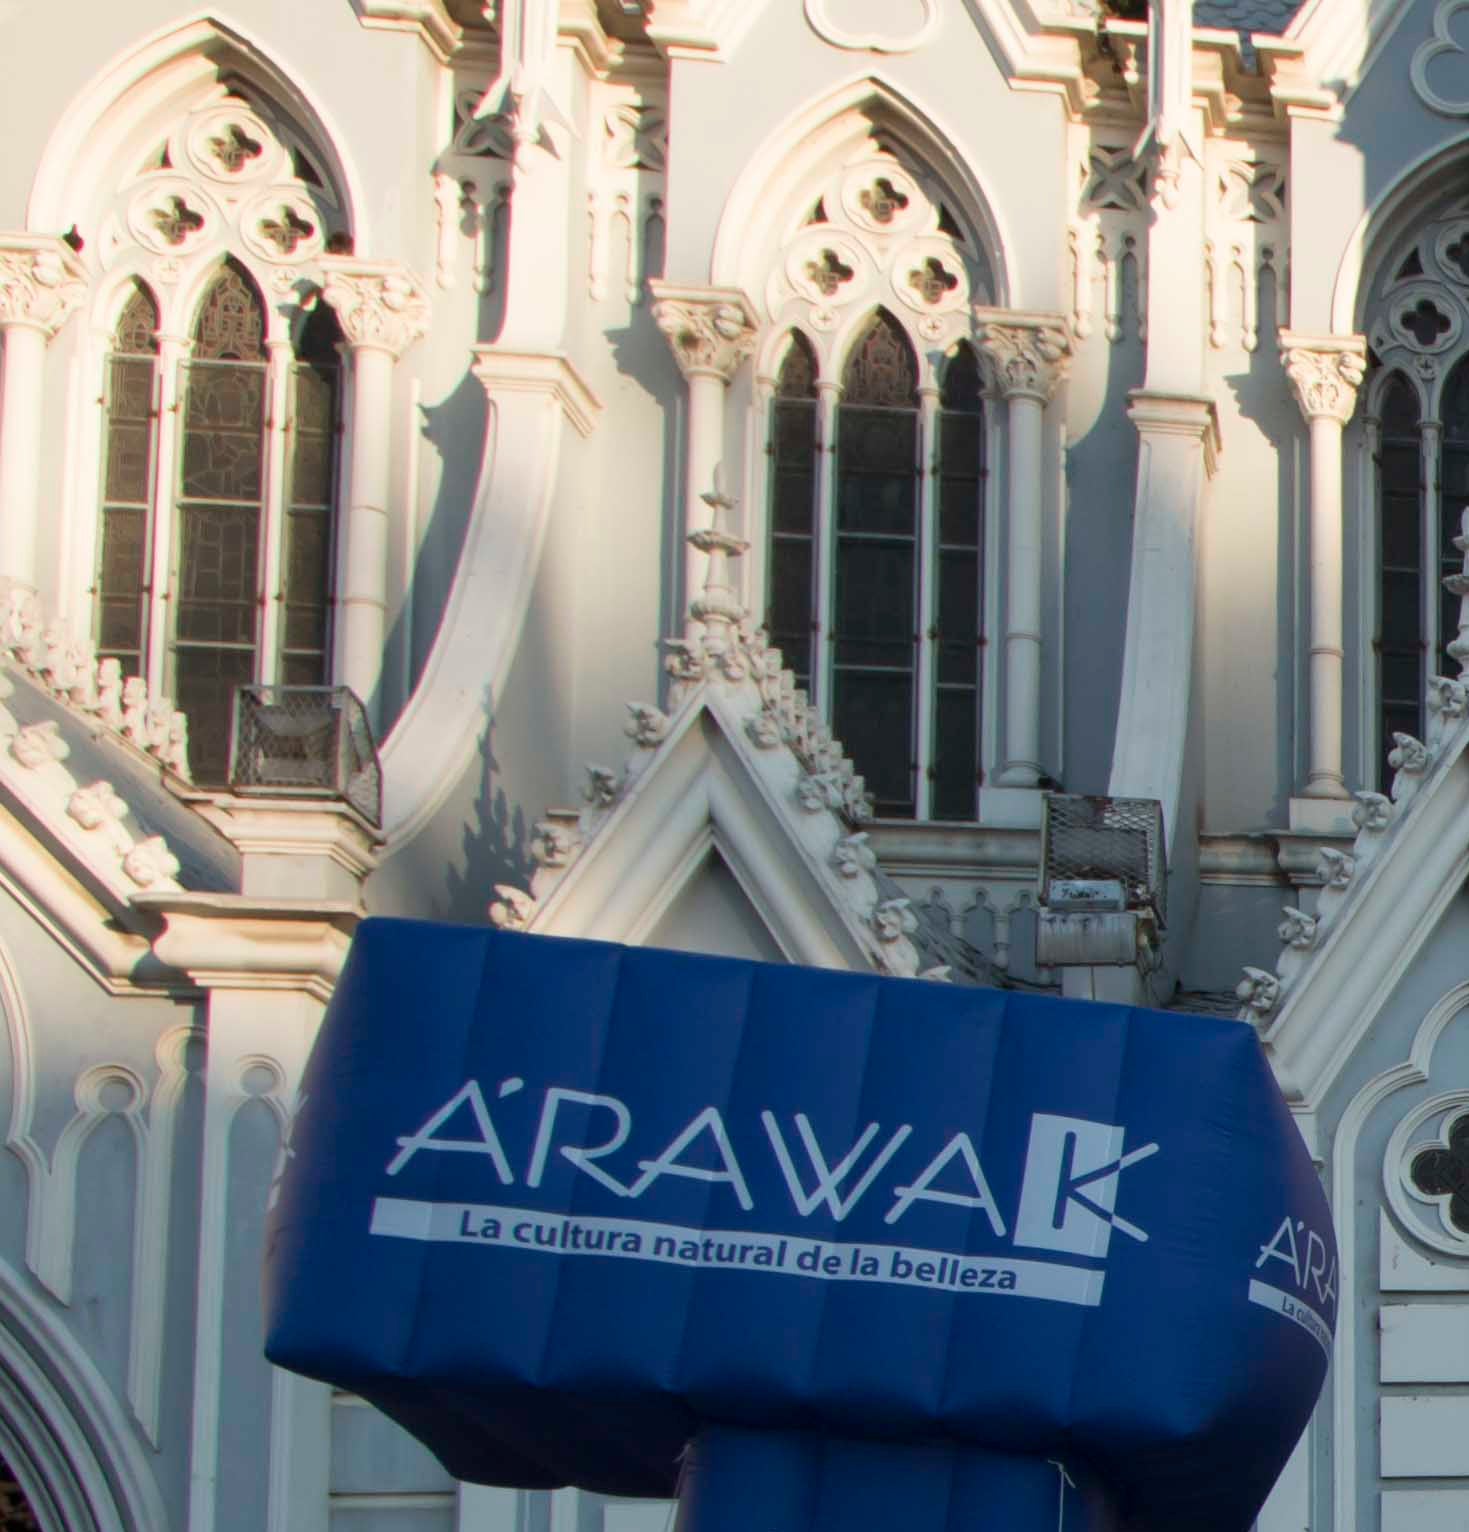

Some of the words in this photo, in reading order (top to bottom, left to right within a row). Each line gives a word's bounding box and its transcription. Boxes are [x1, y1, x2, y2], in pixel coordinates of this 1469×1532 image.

[459, 1209, 500, 1240] La
[512, 1215, 641, 1253] cultura
[654, 1234, 786, 1268] natural
[797, 1245, 842, 1276] de
[851, 1248, 880, 1277] la
[890, 1252, 1017, 1291] belleza
